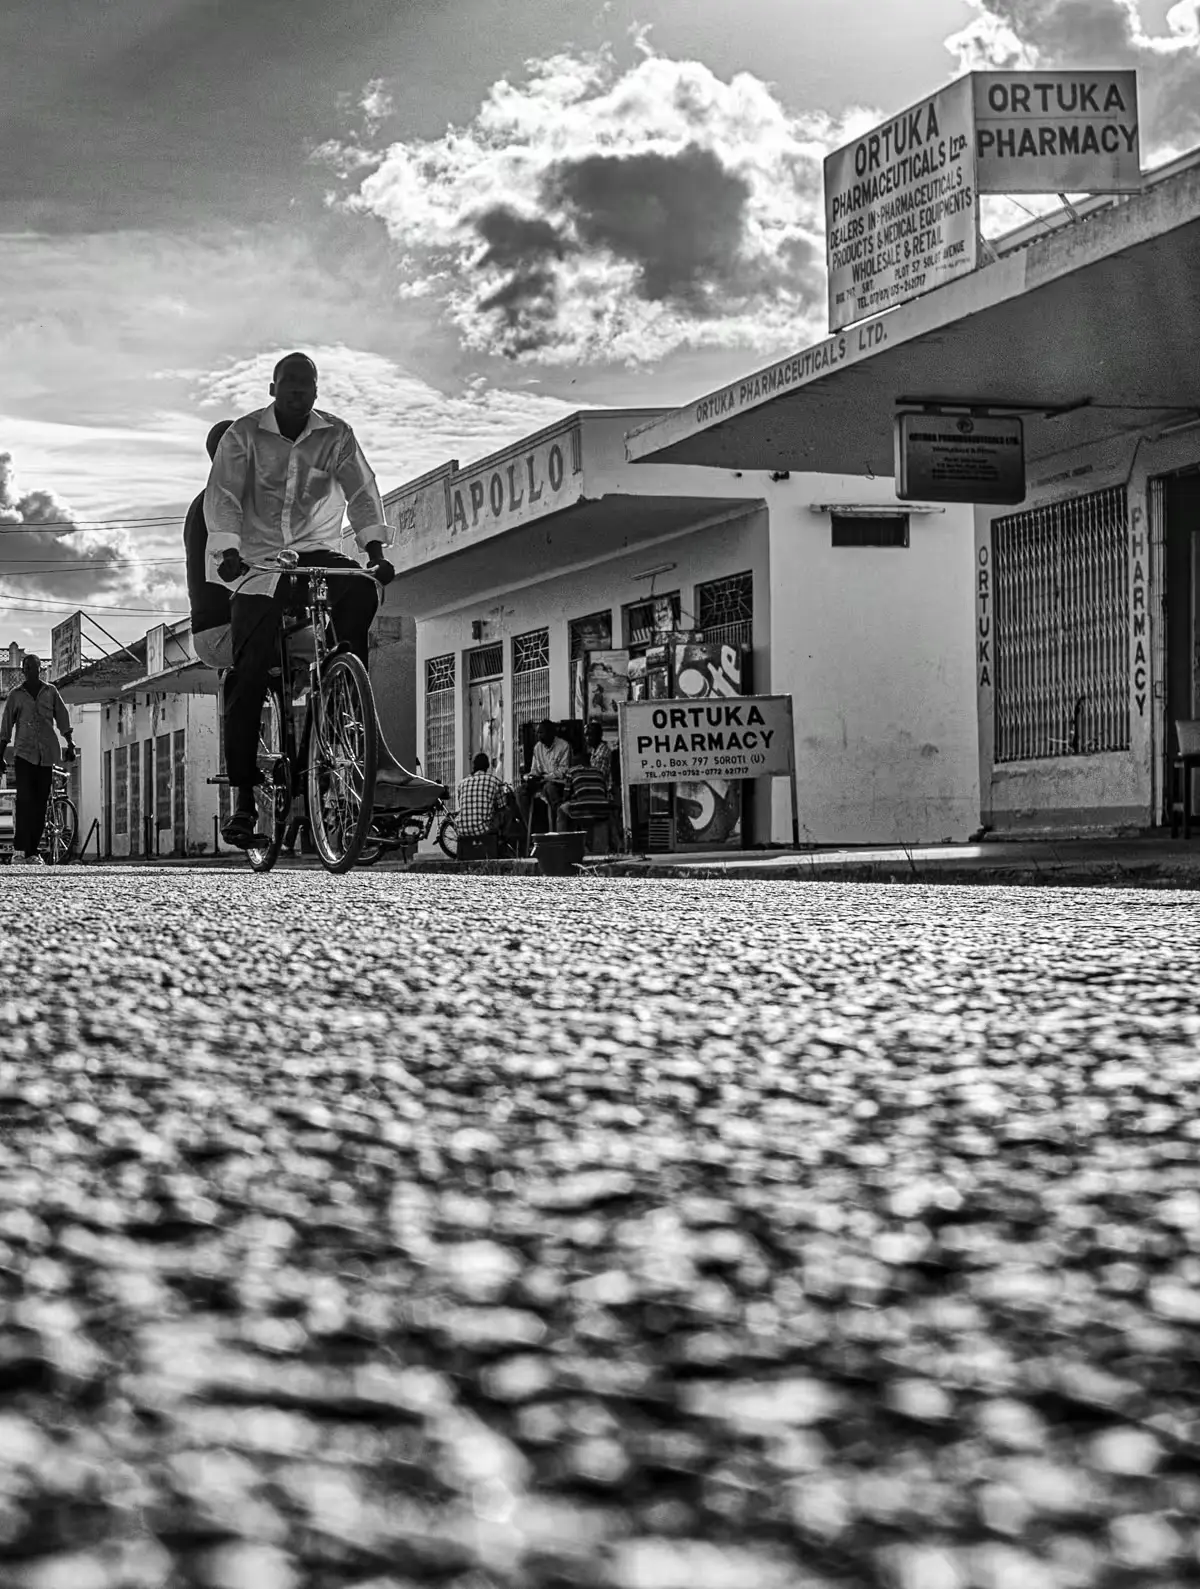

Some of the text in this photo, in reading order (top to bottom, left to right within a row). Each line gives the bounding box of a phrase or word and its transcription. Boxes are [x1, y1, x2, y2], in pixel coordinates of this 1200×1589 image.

[988, 83, 1126, 113] ORTUKA
[855, 102, 939, 178] ORTUKA
[978, 124, 1138, 158] PHARMACY
[832, 140, 946, 223] PHARMACEUTICALS
[830, 216, 865, 251] DEALERS
[832, 239, 874, 271] PRODUCTS
[884, 219, 917, 246] MEDICAL
[919, 186, 972, 229] EQUIPMENTS
[852, 246, 901, 283] WHOLESALE
[943, 239, 965, 261] AVENUE
[696, 321, 888, 423] ORTUKA PHARMACEUTICALS LTD.
[451, 444, 563, 536] APOLLO
[978, 545, 990, 687] ORTUKA
[1131, 506, 1146, 717] PHARMACY
[652, 705, 766, 729] ORTUKA
[637, 730, 774, 755] PHARMACY
[669, 757, 688, 767] Box
[692, 756, 708, 765] 797
[713, 754, 746, 765] SOROTI
[750, 752, 765, 764] (U)
